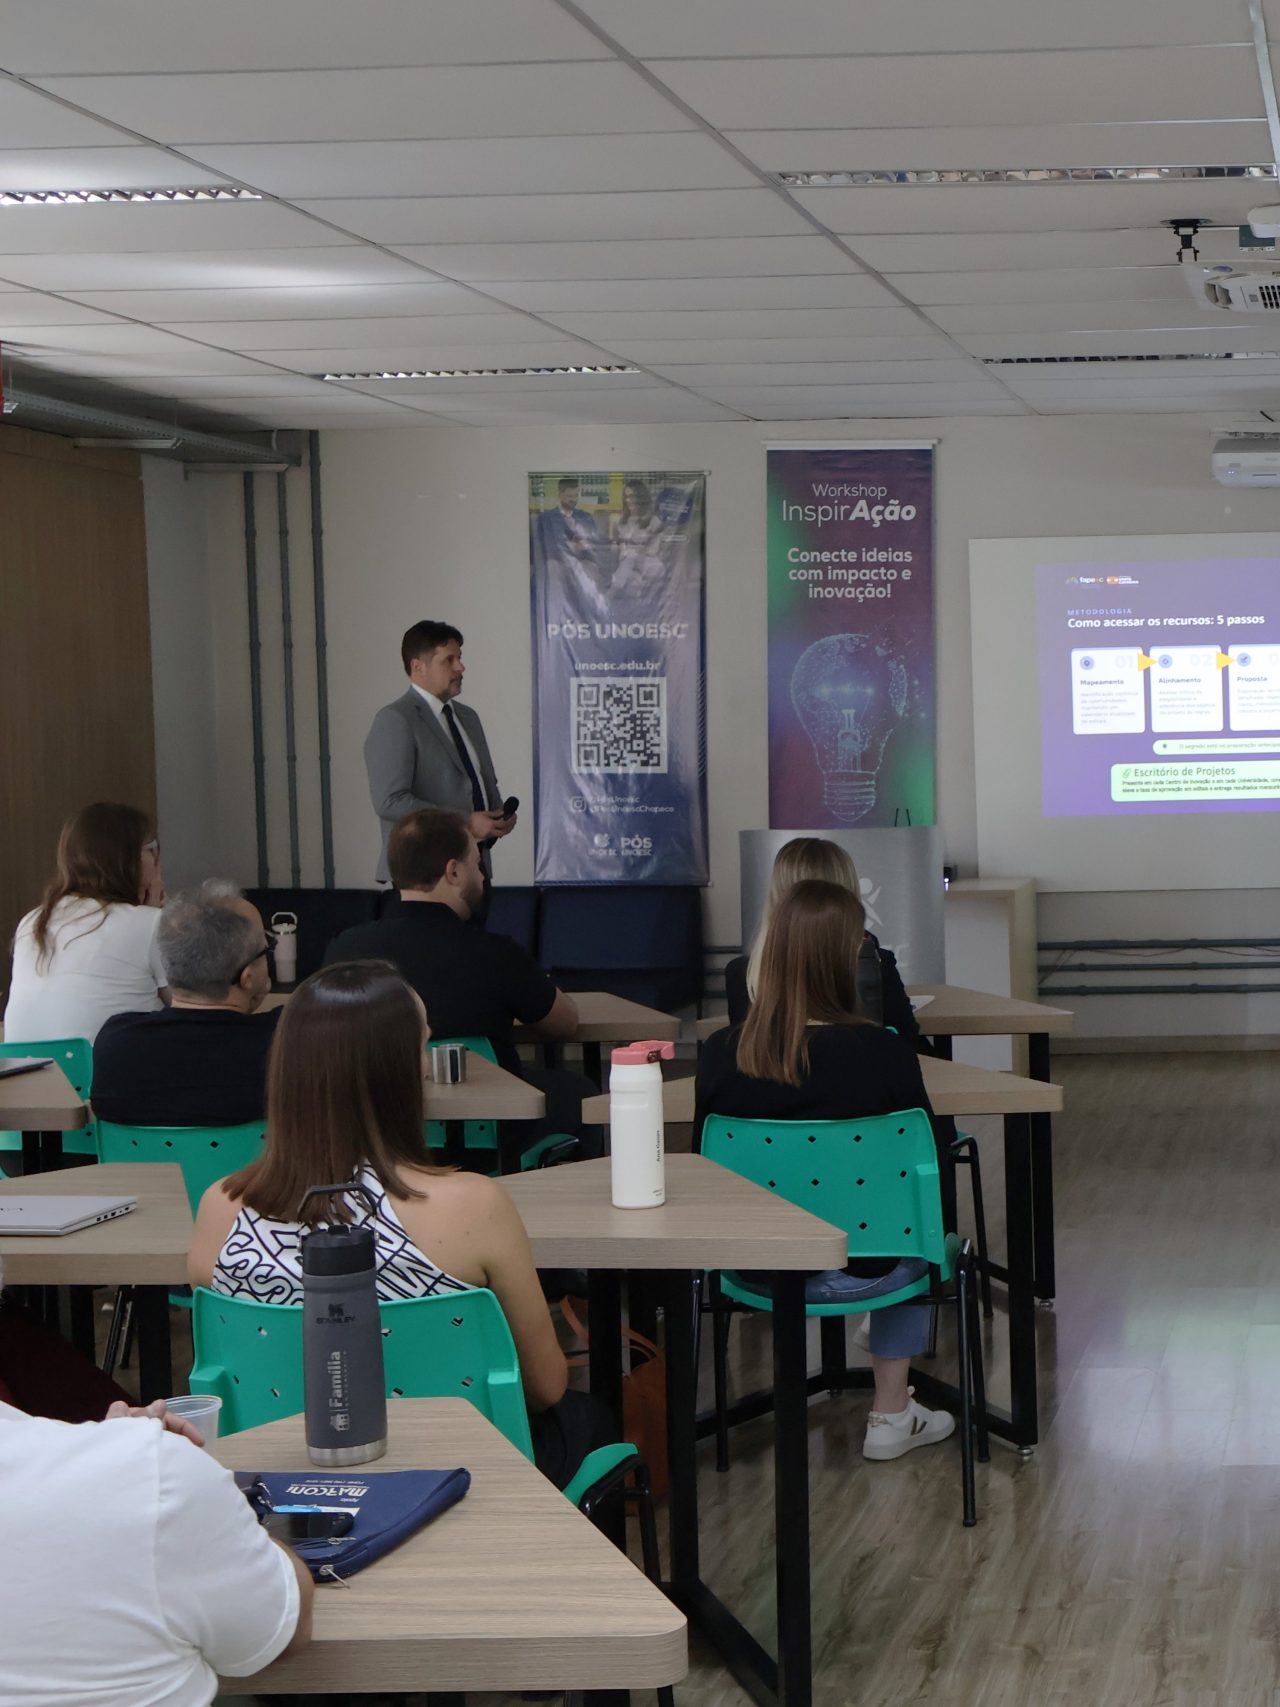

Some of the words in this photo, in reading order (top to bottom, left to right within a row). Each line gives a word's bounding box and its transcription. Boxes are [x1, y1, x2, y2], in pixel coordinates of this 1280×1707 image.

[812, 483, 888, 500] Workshop
[782, 499, 917, 528] InspirAção
[787, 547, 858, 564] Conecte
[861, 547, 913, 564] ideias
[788, 568, 824, 581] com
[828, 566, 898, 585] impacto
[901, 568, 912, 580] e
[808, 584, 892, 603] inovação!
[1068, 618, 1101, 628] Como
[1104, 618, 1144, 628] acessar
[1148, 618, 1161, 626] os
[1163, 616, 1214, 626] recursos:
[1216, 614, 1225, 625] 5
[1226, 615, 1265, 626] passos
[547, 620, 591, 640] PÓS
[595, 622, 688, 639] UNOESC
[574, 660, 660, 671] unoesc.edu.br
[1134, 768, 1179, 777] Escritório
[1182, 767, 1193, 776] de
[1196, 766, 1236, 777] Projetos
[620, 834, 653, 849] PÓS
